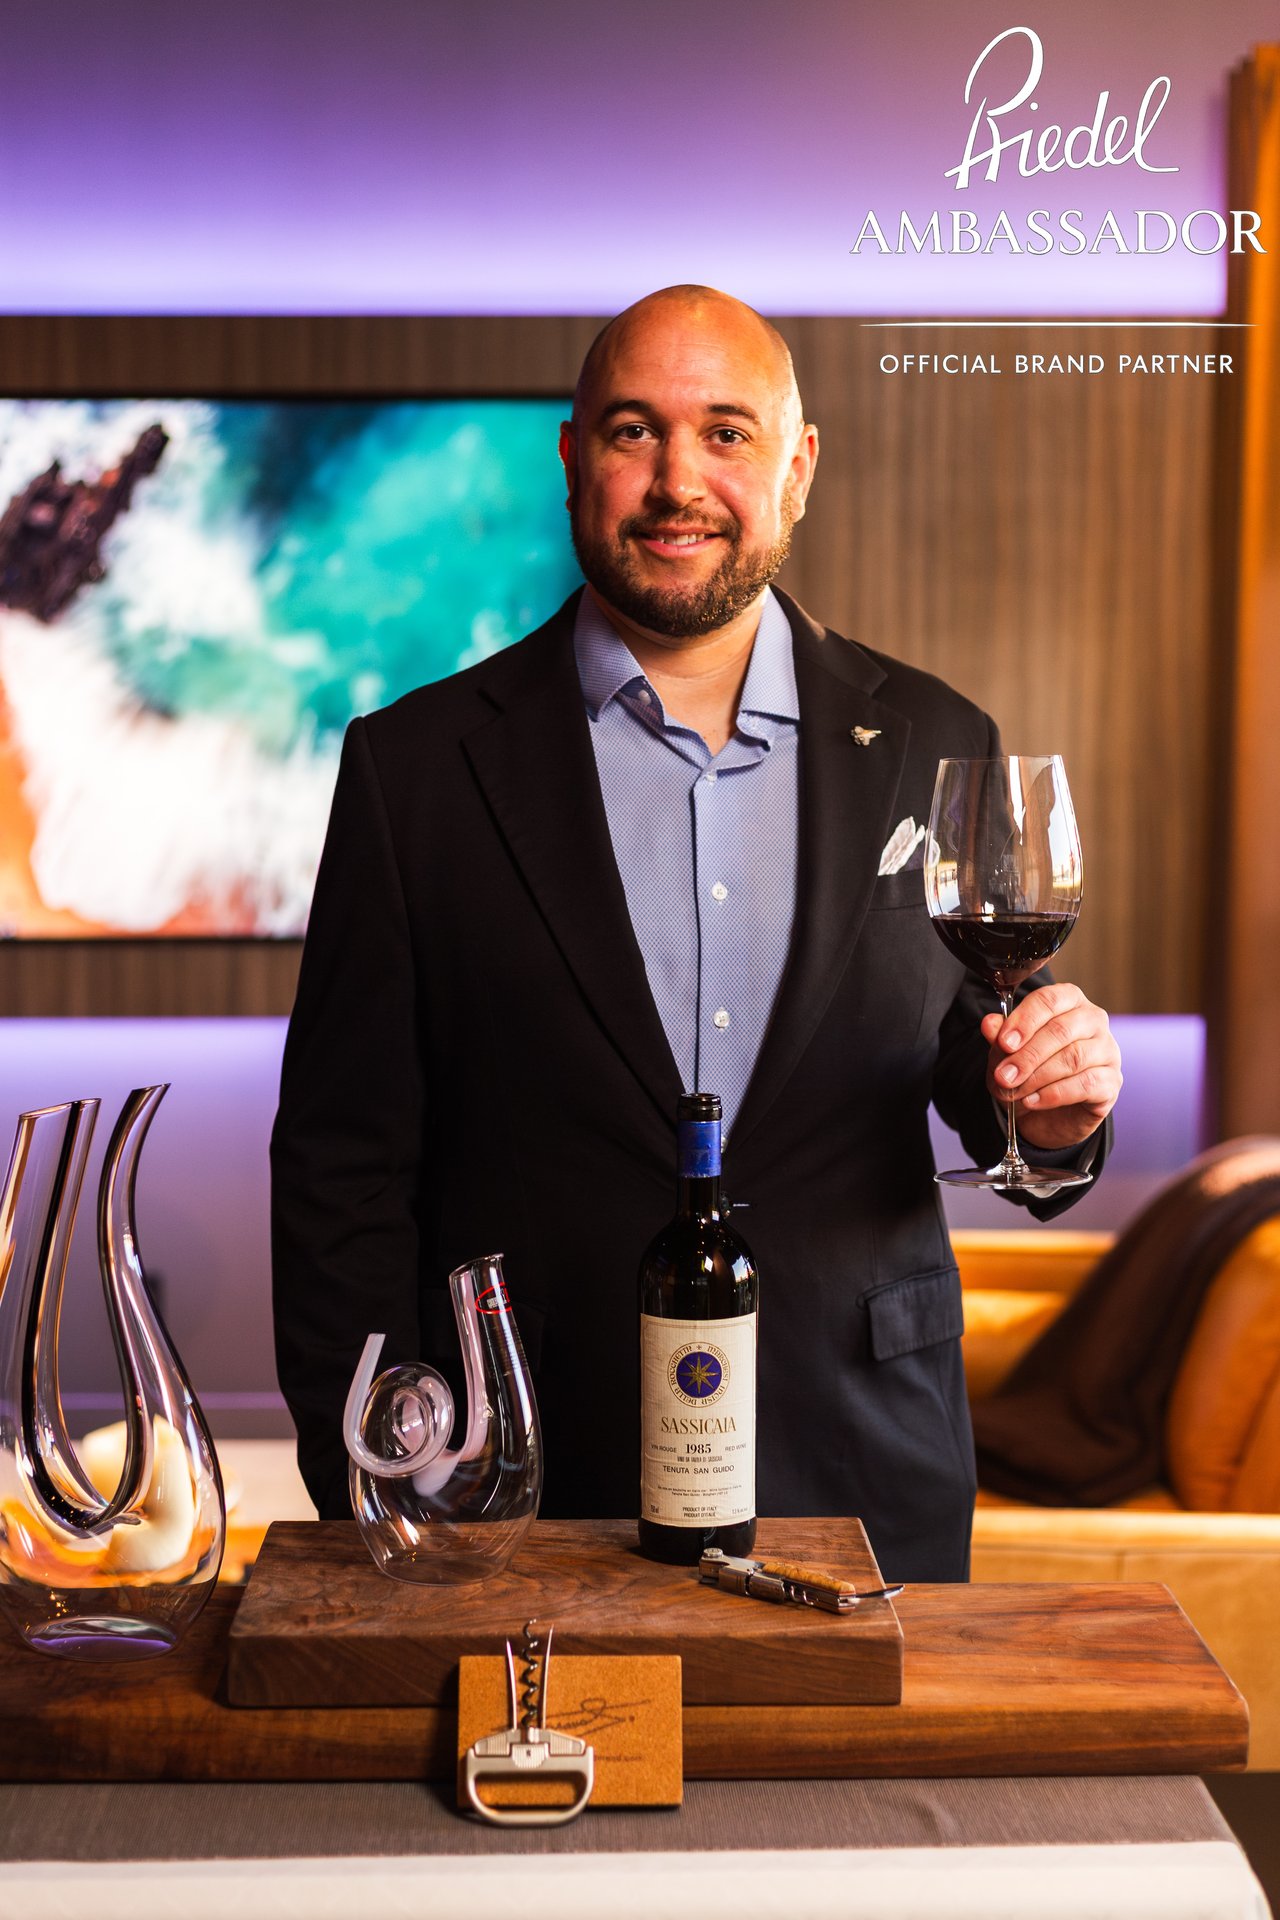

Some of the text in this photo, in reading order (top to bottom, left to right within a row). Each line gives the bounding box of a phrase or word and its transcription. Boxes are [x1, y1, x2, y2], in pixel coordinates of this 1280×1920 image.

[661, 1416, 736, 1435] SASSICAIA
[686, 1443, 712, 1455] 1985
[663, 1465, 735, 1475] TENUTA SAN GUIDO
